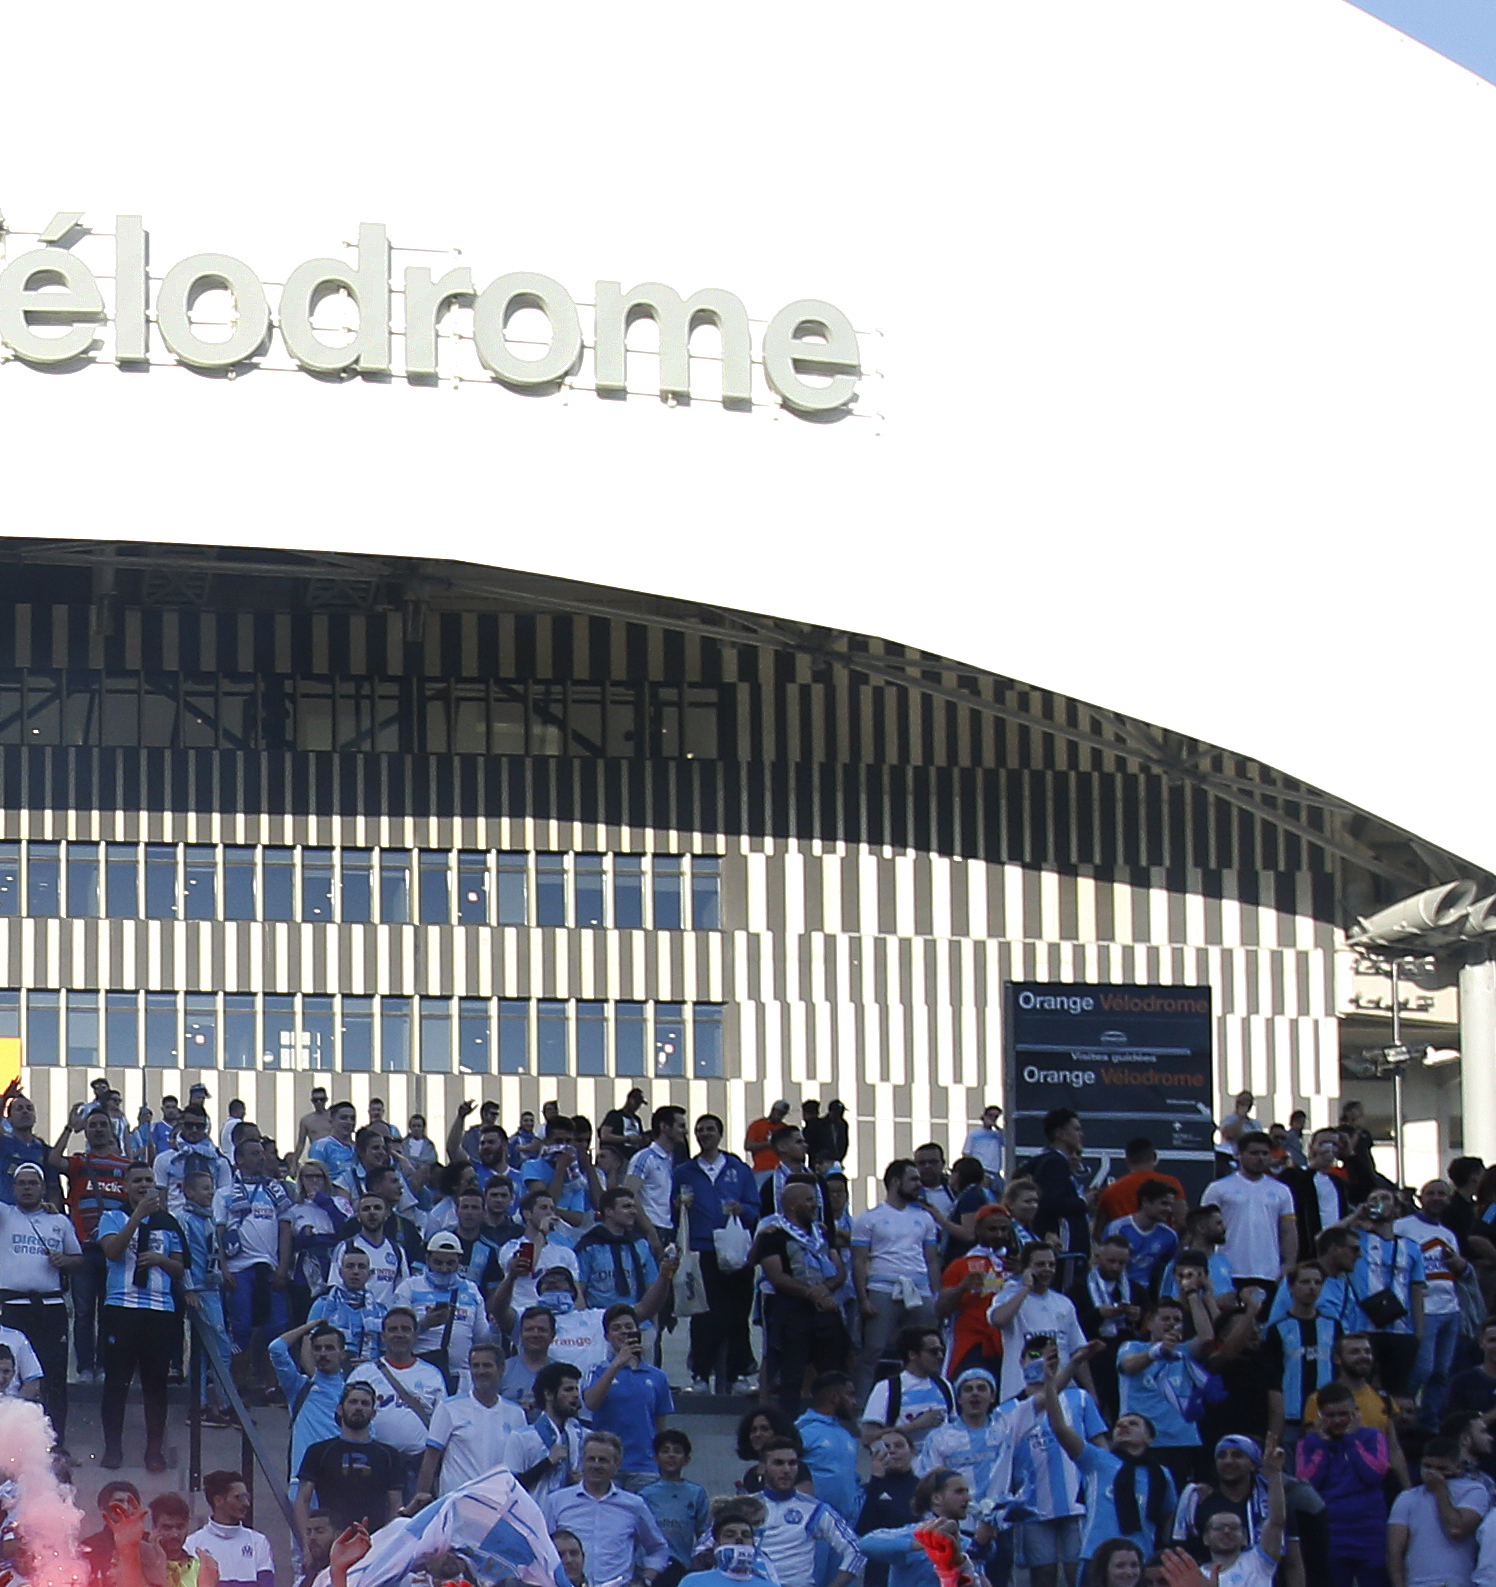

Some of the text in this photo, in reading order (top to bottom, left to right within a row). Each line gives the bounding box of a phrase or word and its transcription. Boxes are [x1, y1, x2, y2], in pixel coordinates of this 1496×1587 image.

[1019, 991, 1208, 1014] Orange Vélodrome
[1023, 1065, 1205, 1088] Orange Vélodrome
